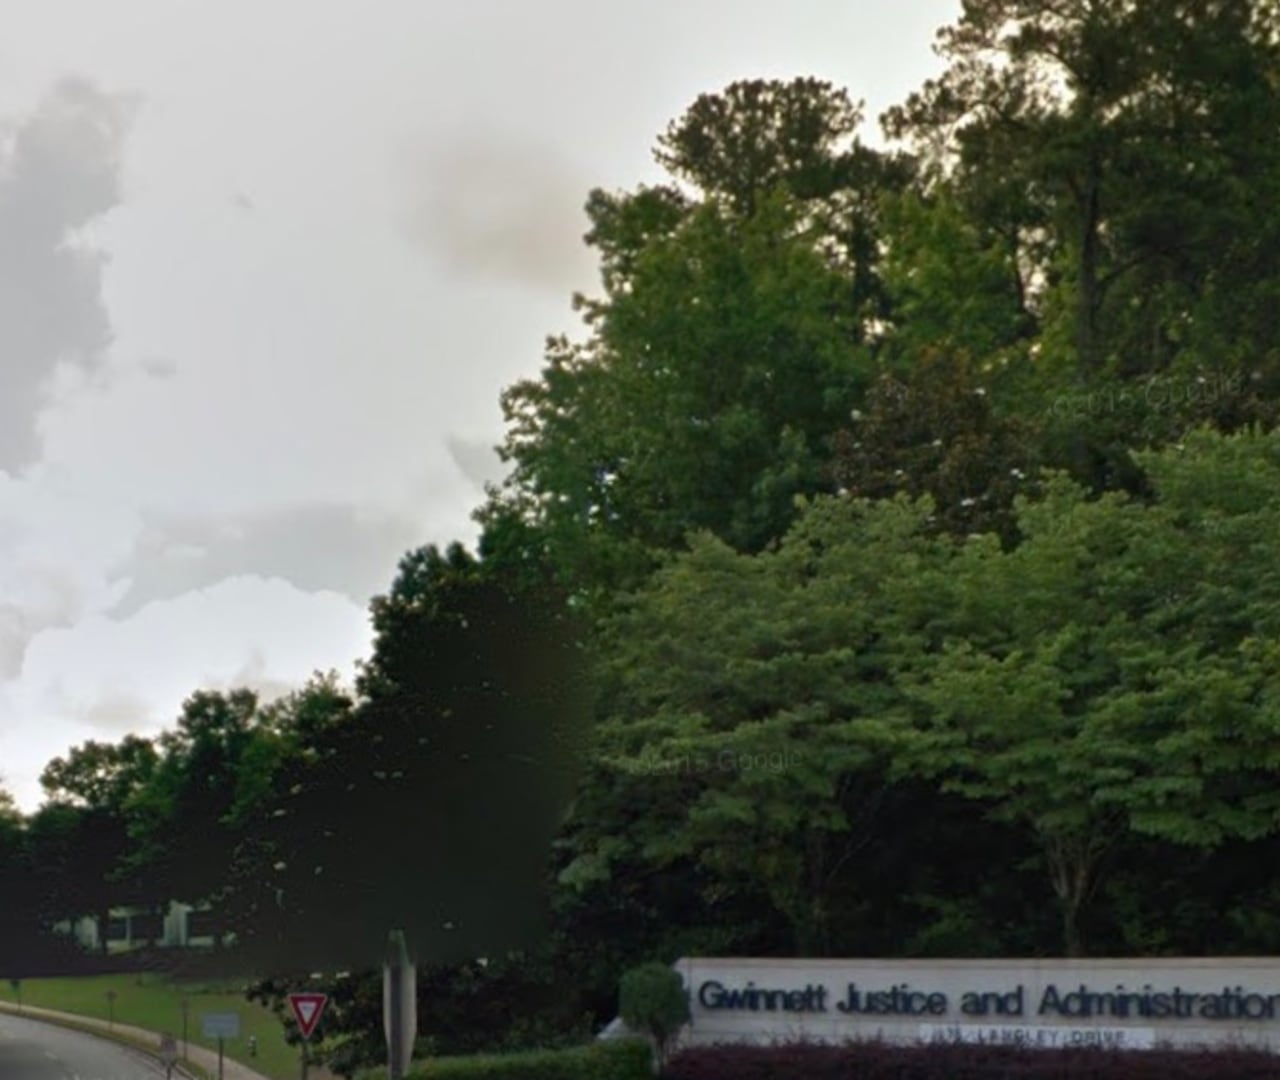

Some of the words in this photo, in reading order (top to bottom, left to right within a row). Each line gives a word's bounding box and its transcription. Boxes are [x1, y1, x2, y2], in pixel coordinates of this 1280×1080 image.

[699, 980, 827, 1013] Gwinnett
[837, 982, 947, 1015] Justice
[961, 984, 1022, 1016] and
[1072, 1029, 1127, 1045] DRIVE
